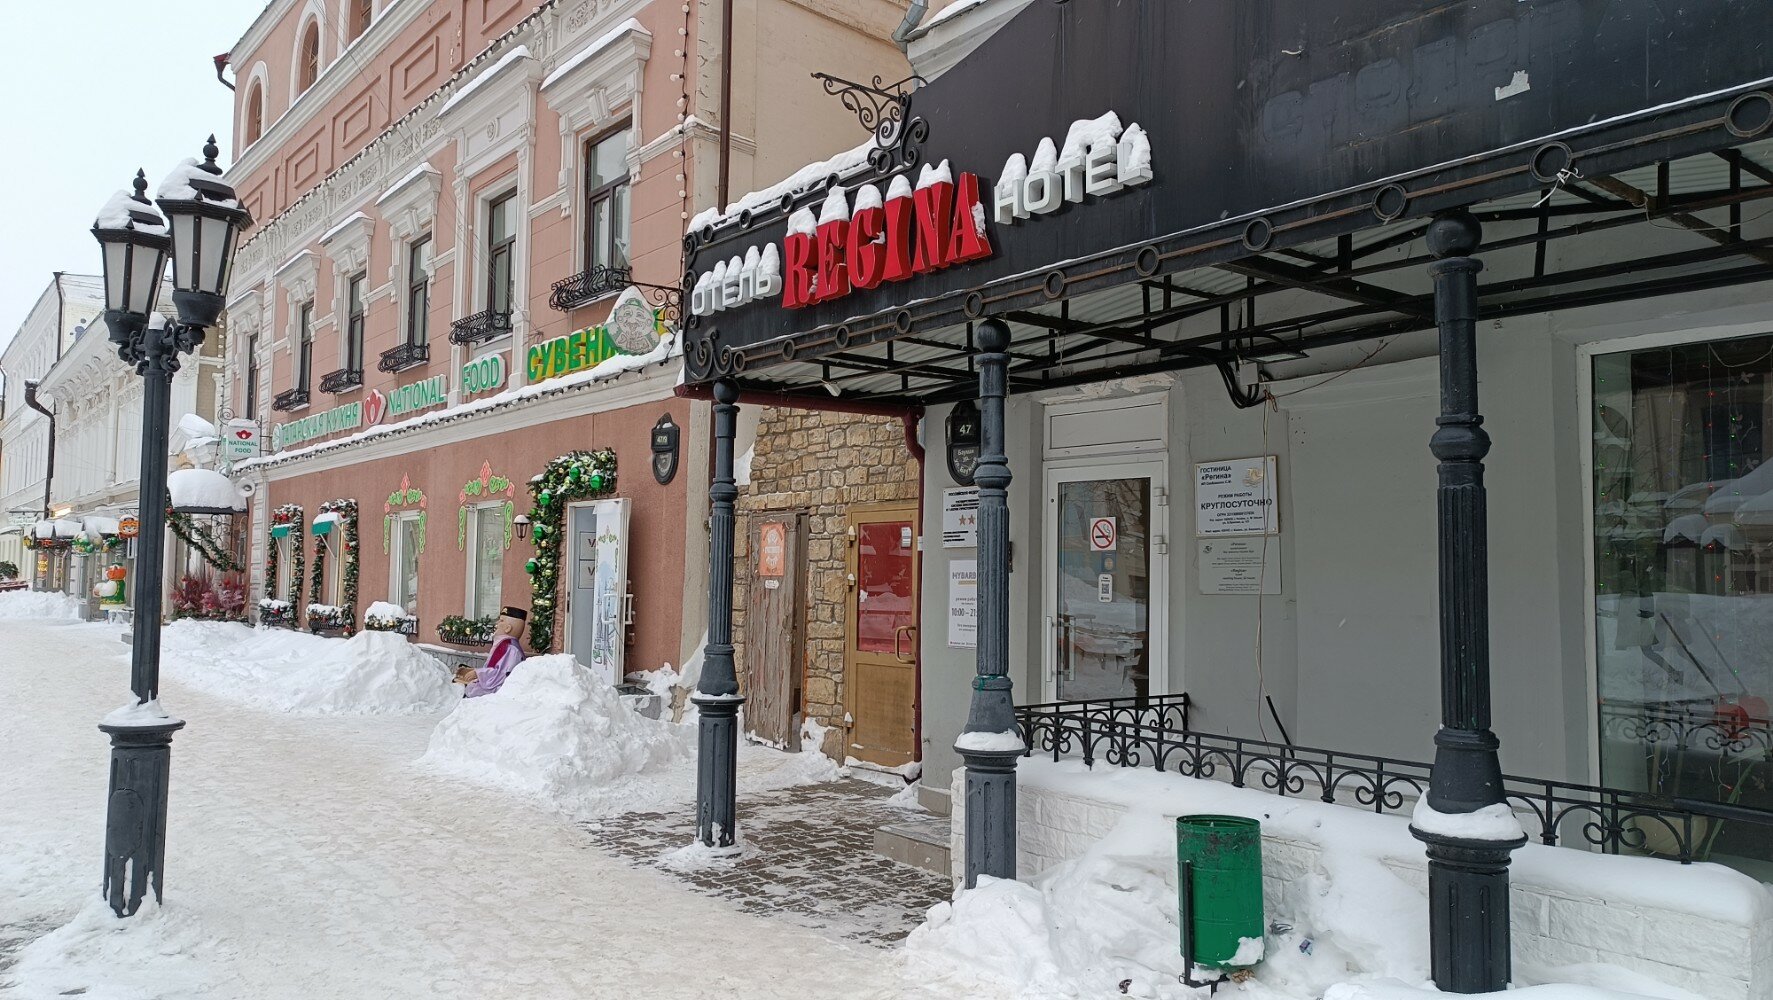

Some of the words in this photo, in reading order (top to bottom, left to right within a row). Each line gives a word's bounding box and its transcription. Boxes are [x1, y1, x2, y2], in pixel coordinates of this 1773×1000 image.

[994, 142, 1153, 225] HOTEL
[782, 172, 992, 309] REGINA
[692, 268, 783, 316] ОТЕЛЬ
[389, 377, 445, 413] NATIONAL
[462, 356, 501, 396] FOOD
[959, 424, 972, 435] 47
[1200, 465, 1232, 474] ГОСТИНИЦА
[1201, 473, 1232, 481] «Регина»
[1200, 498, 1273, 511] КРУГЛОСУТОЧНО
[952, 571, 977, 580] MYBARB
[951, 607, 965, 617] 10:00
